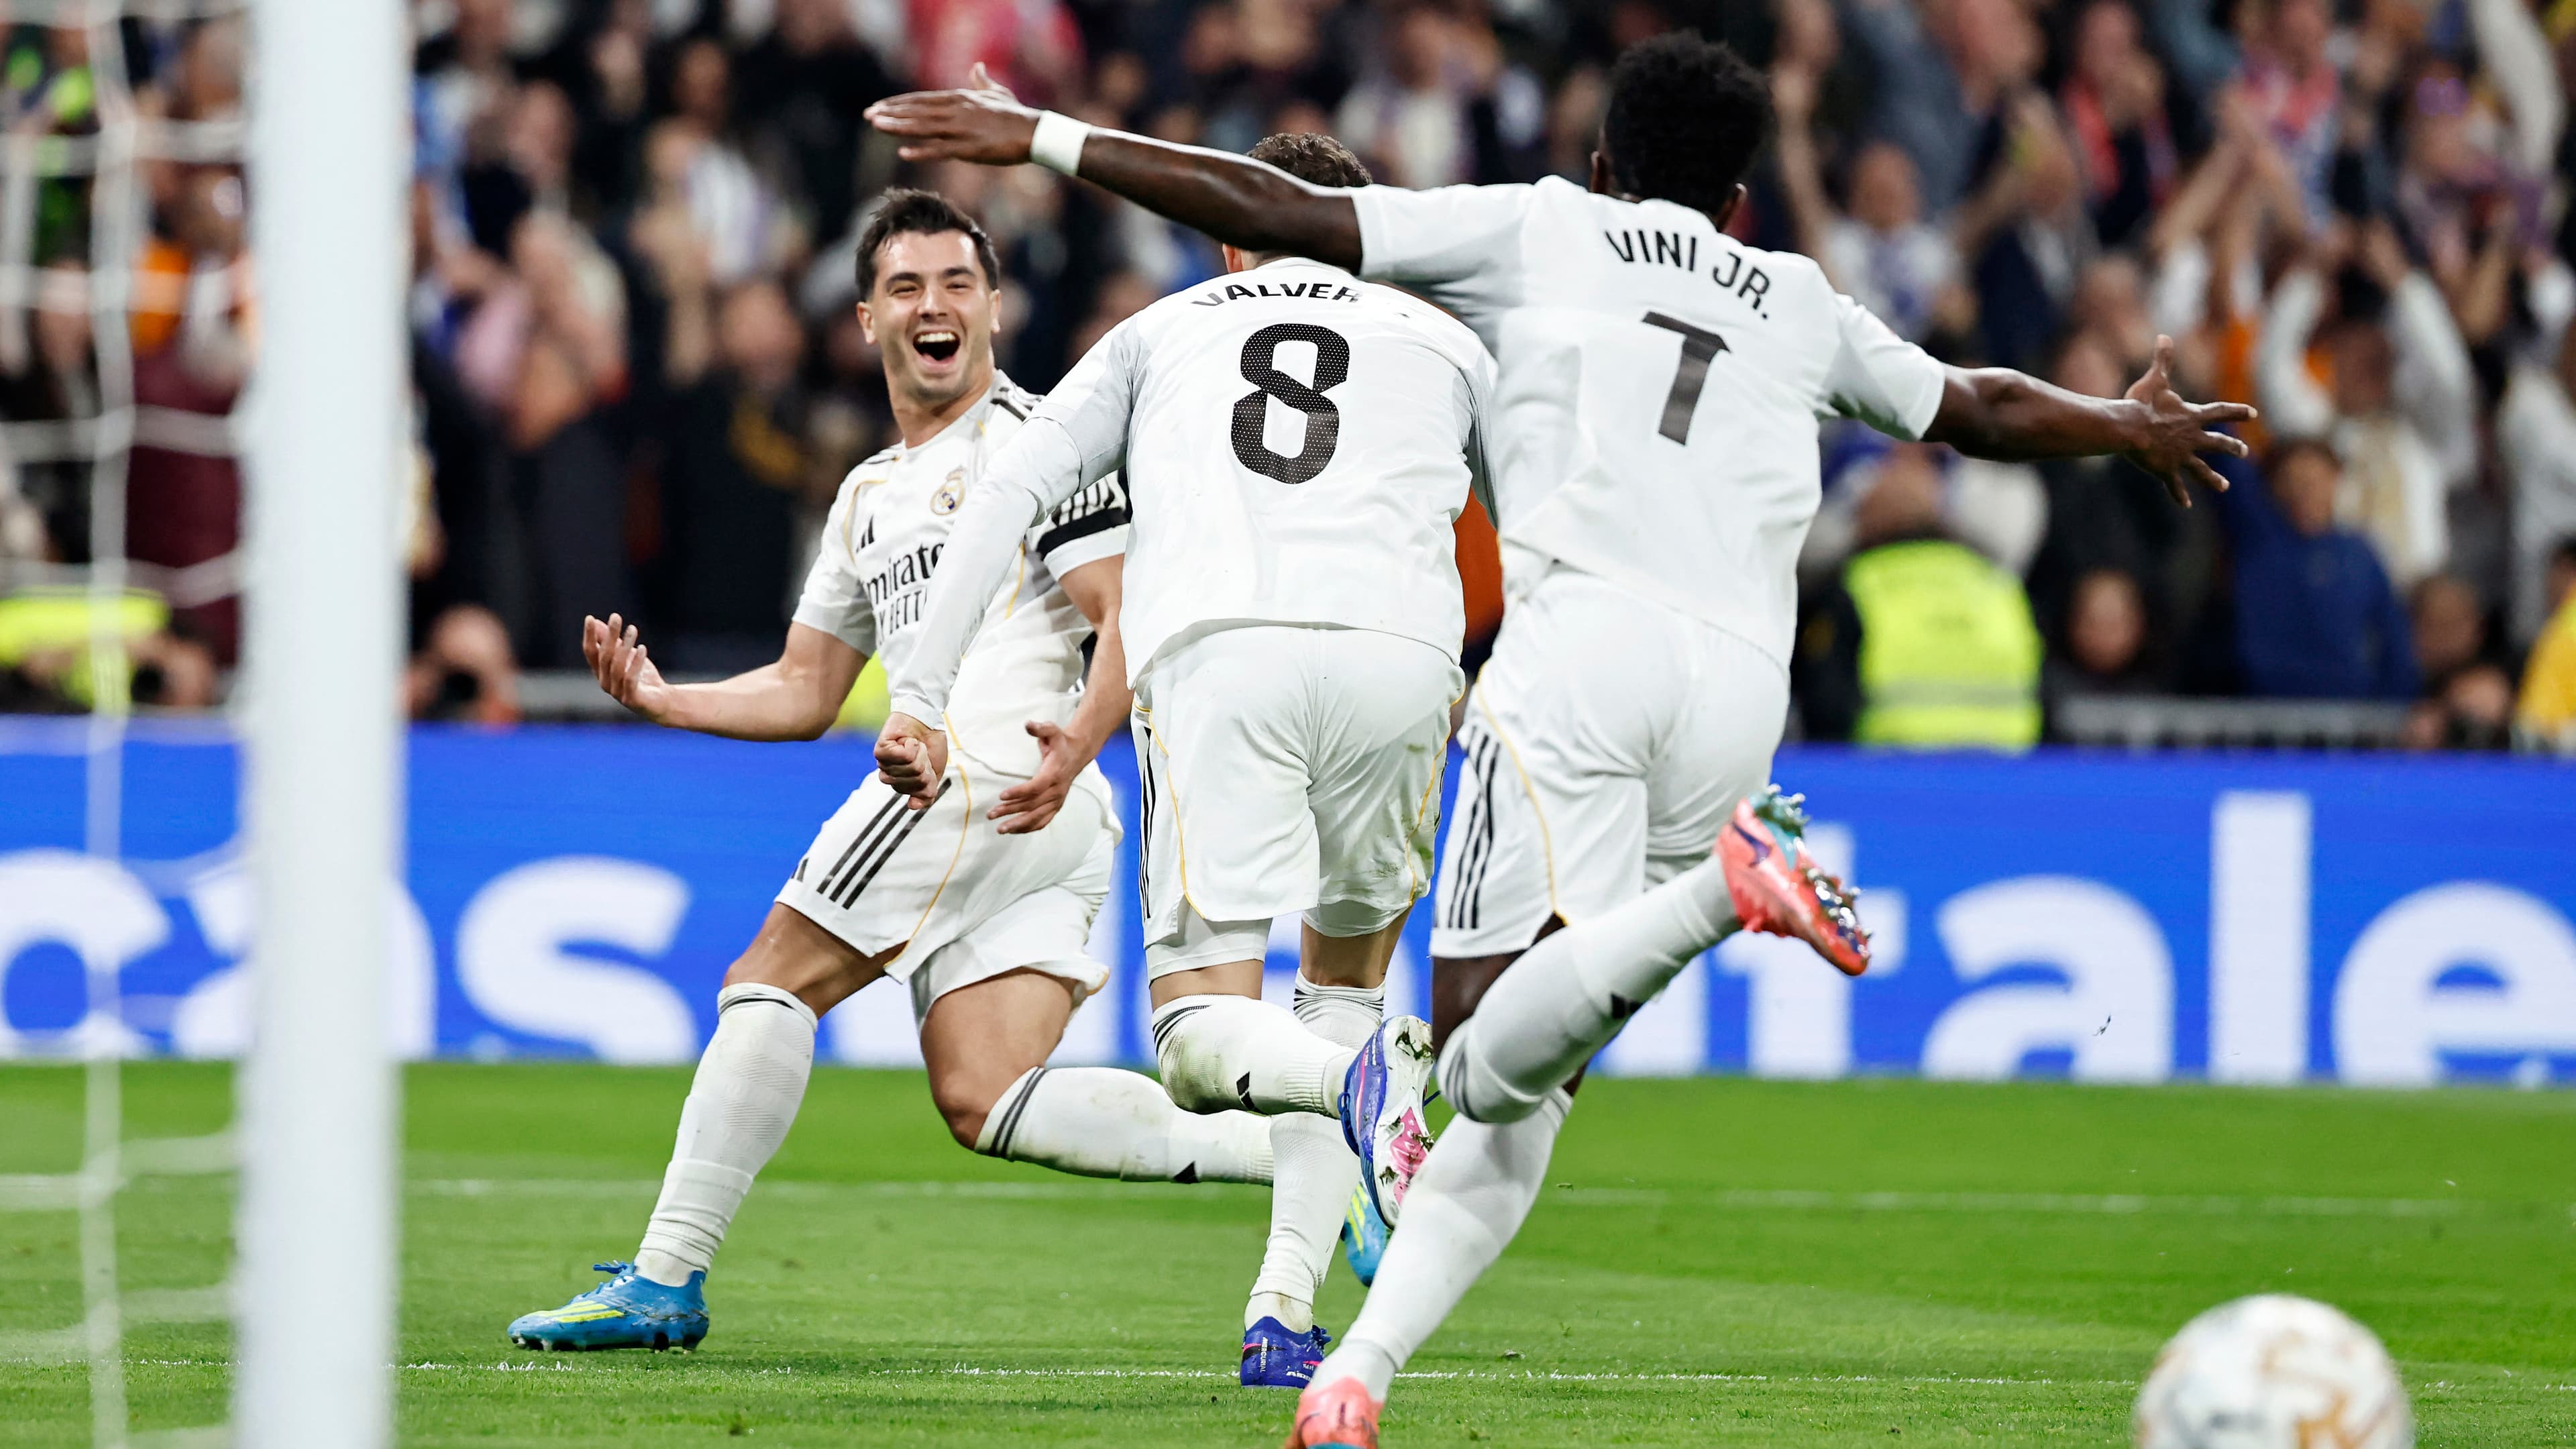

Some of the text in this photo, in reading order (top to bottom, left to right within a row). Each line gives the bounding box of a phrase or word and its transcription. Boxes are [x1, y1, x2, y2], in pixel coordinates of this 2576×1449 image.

[1191, 282, 1364, 307] VALVER
[1604, 229, 1770, 320] VINI JR.
[1230, 323, 1350, 485] 8
[1641, 310, 1732, 447] 7
[866, 543, 945, 605] mirat
[1260, 1336, 1269, 1373] MERCURIAL
